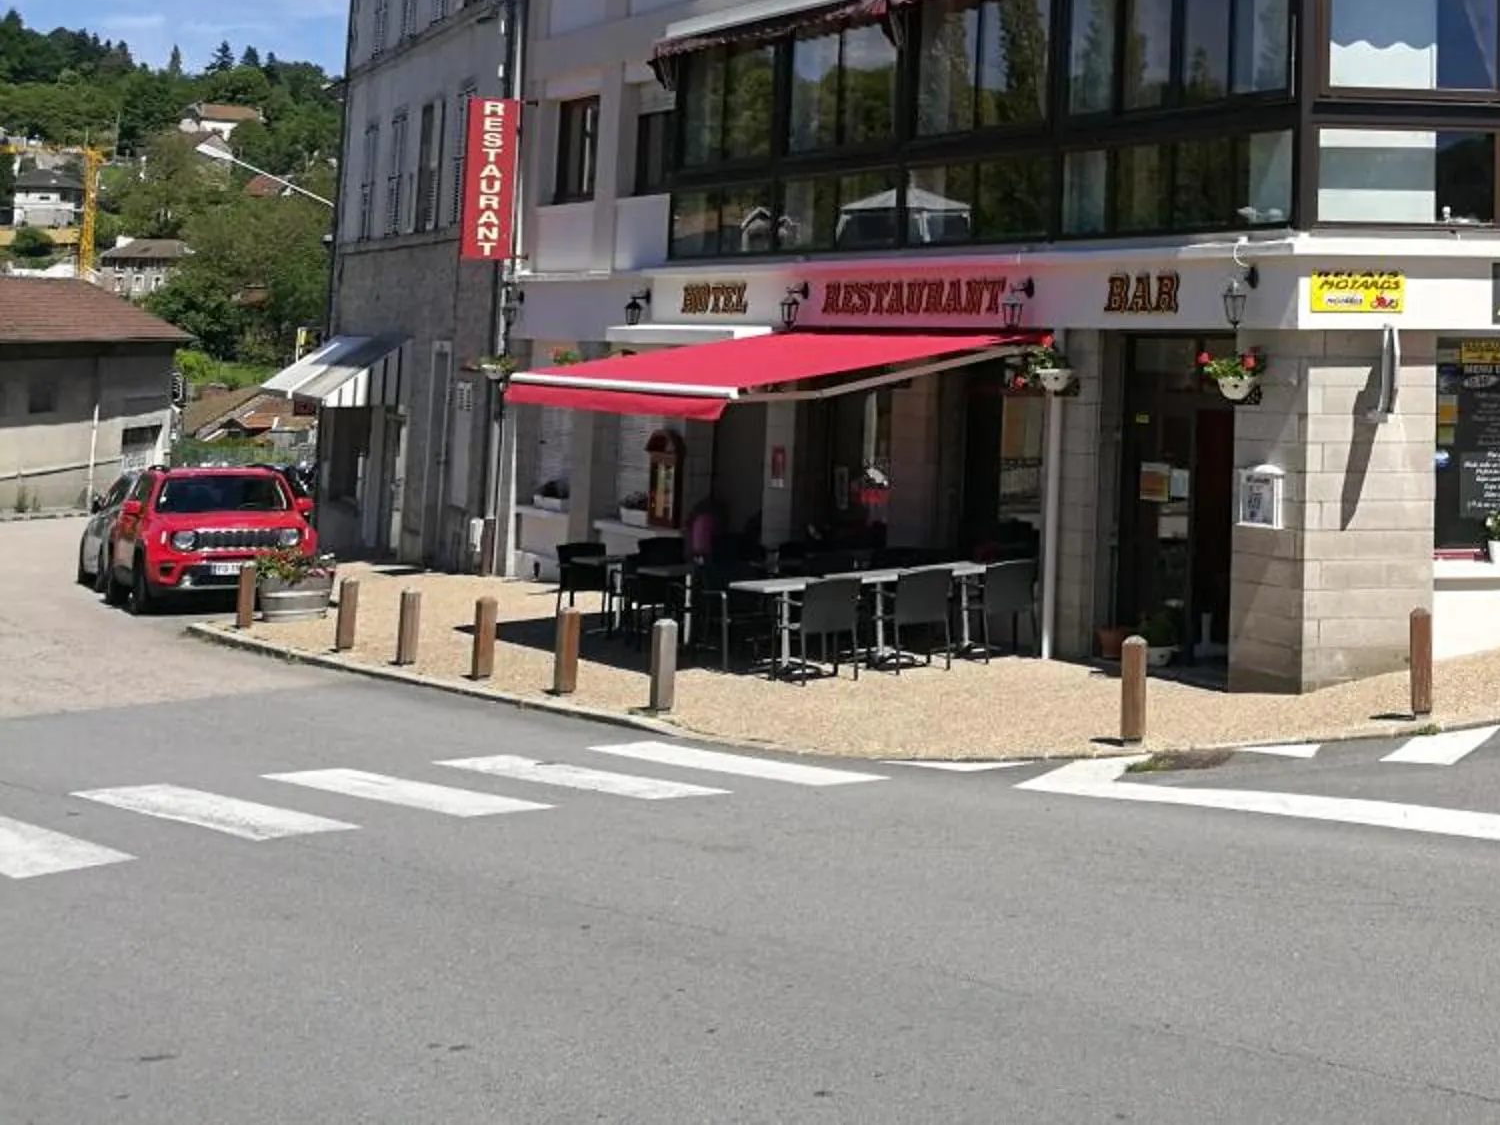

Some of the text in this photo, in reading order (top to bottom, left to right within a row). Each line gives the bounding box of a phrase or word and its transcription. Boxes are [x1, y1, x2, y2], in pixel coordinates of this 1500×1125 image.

[477, 101, 504, 256] RESTAURANT
[681, 280, 748, 313] HOTEL
[822, 277, 1006, 315] RESTAURANT
[1104, 271, 1179, 312] BAR
